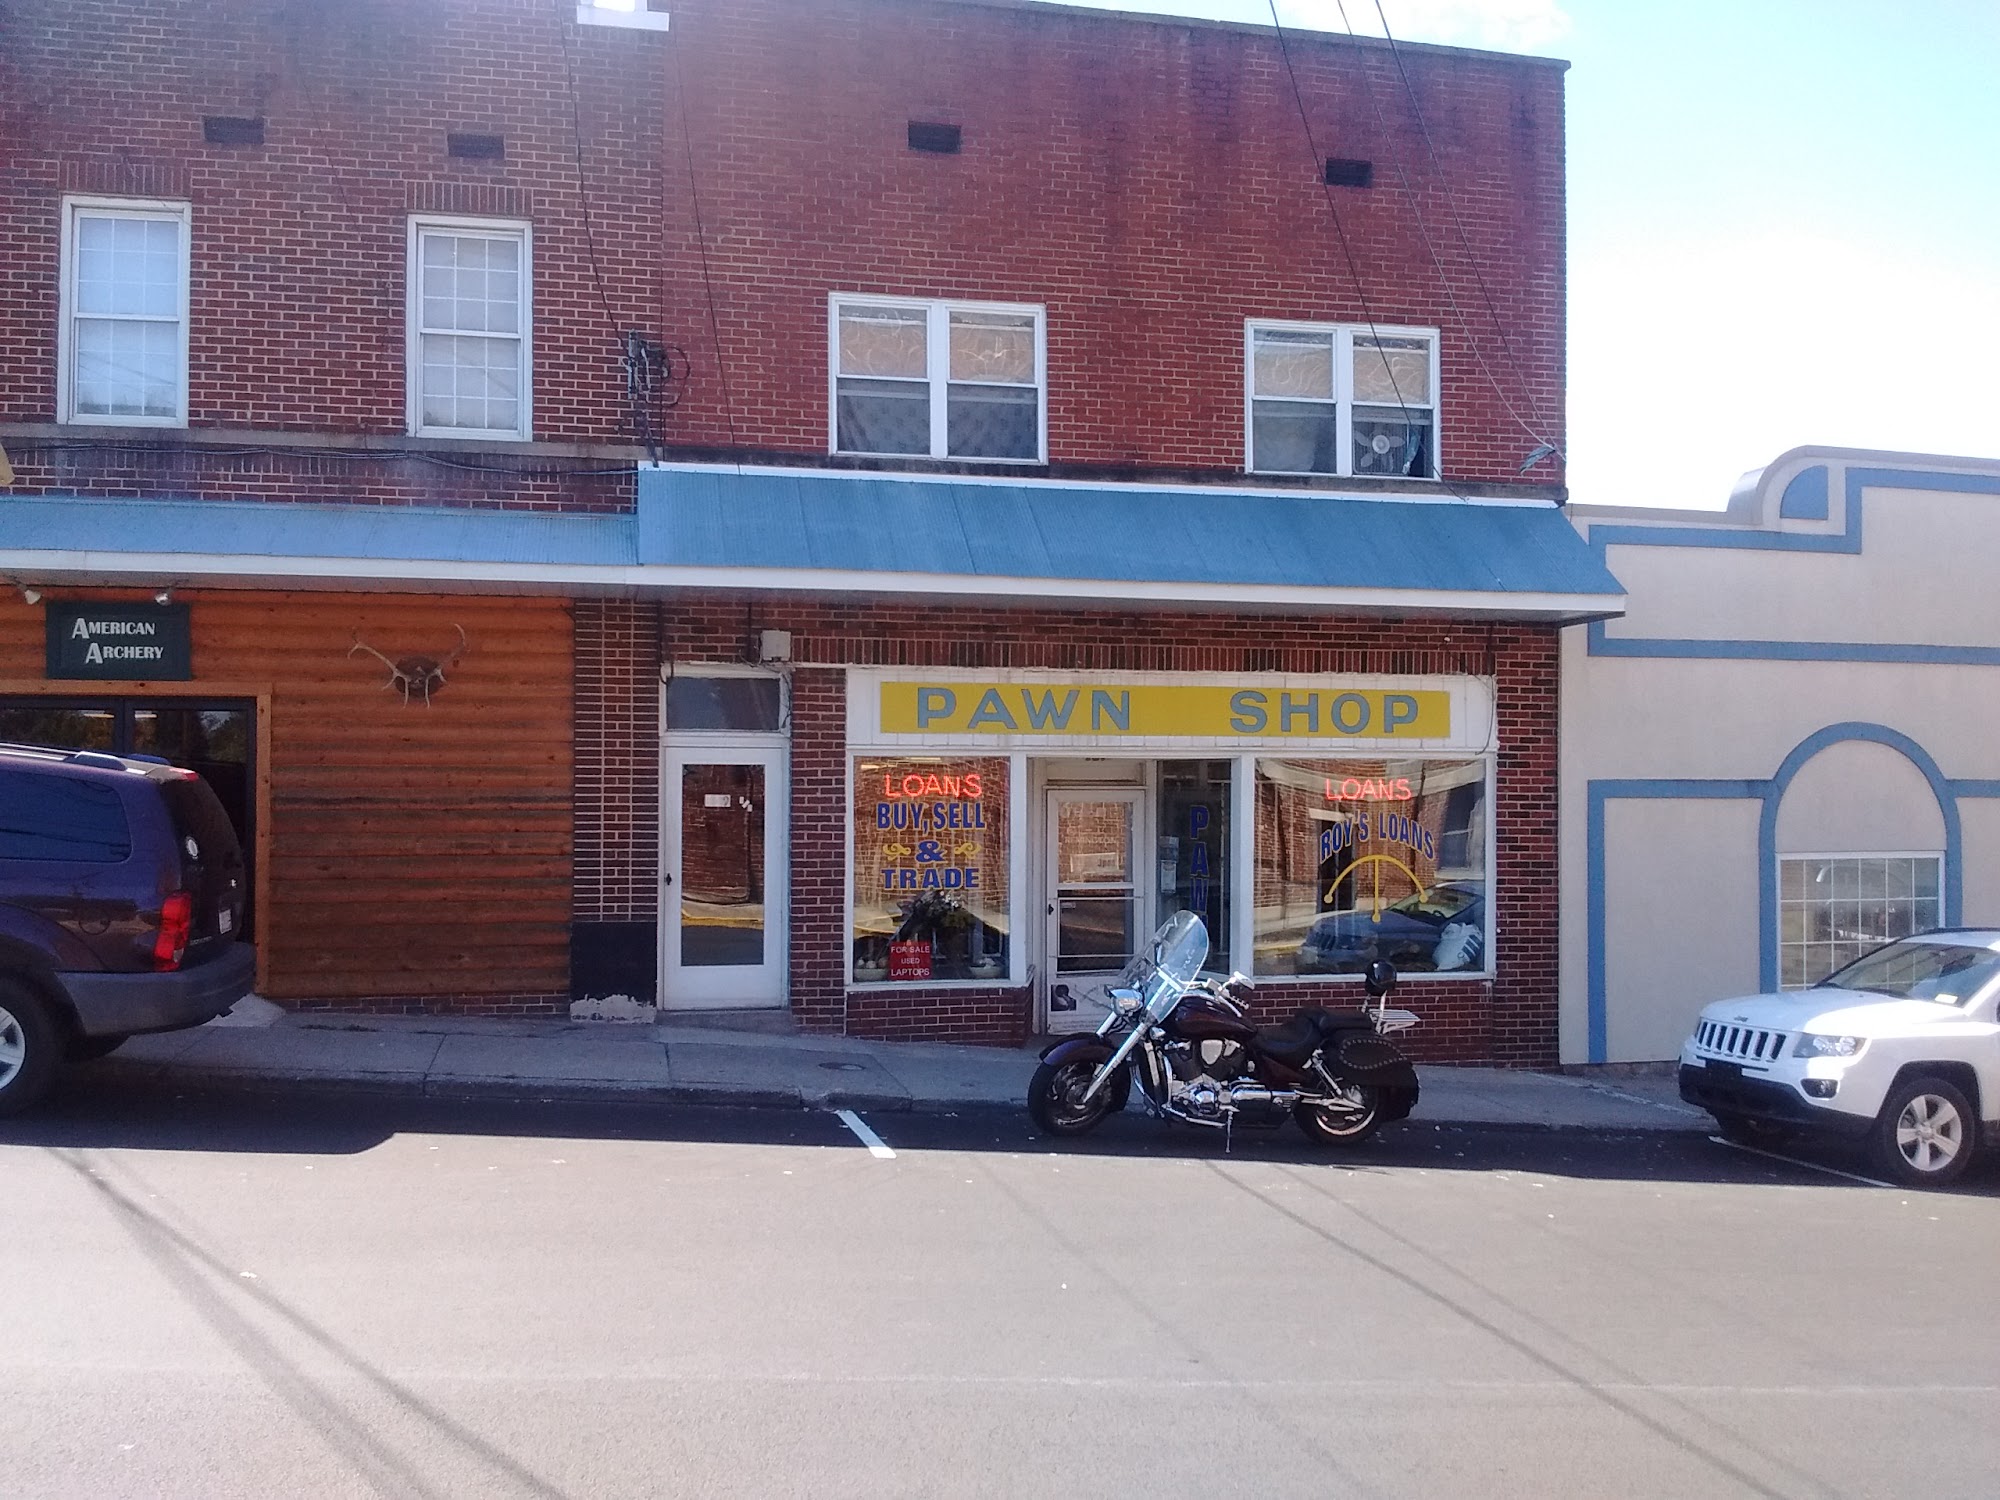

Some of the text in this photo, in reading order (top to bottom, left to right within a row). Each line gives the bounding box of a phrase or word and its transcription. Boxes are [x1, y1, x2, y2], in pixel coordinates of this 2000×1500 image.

[71, 617, 156, 639] AMERICAN
[84, 642, 164, 664] ARCHERY
[917, 687, 1419, 734] PAWN SHOP
[885, 774, 983, 798] LOANS
[1325, 777, 1413, 800] LOANS
[1318, 812, 1436, 865] ROY'S LOANS
[915, 840, 948, 863] &
[881, 867, 982, 890] TRADE
[1190, 804, 1210, 932] PAW
[891, 945, 930, 954] FOR SALE
[901, 957, 920, 965] USED
[891, 967, 930, 977] LAPTOPS
